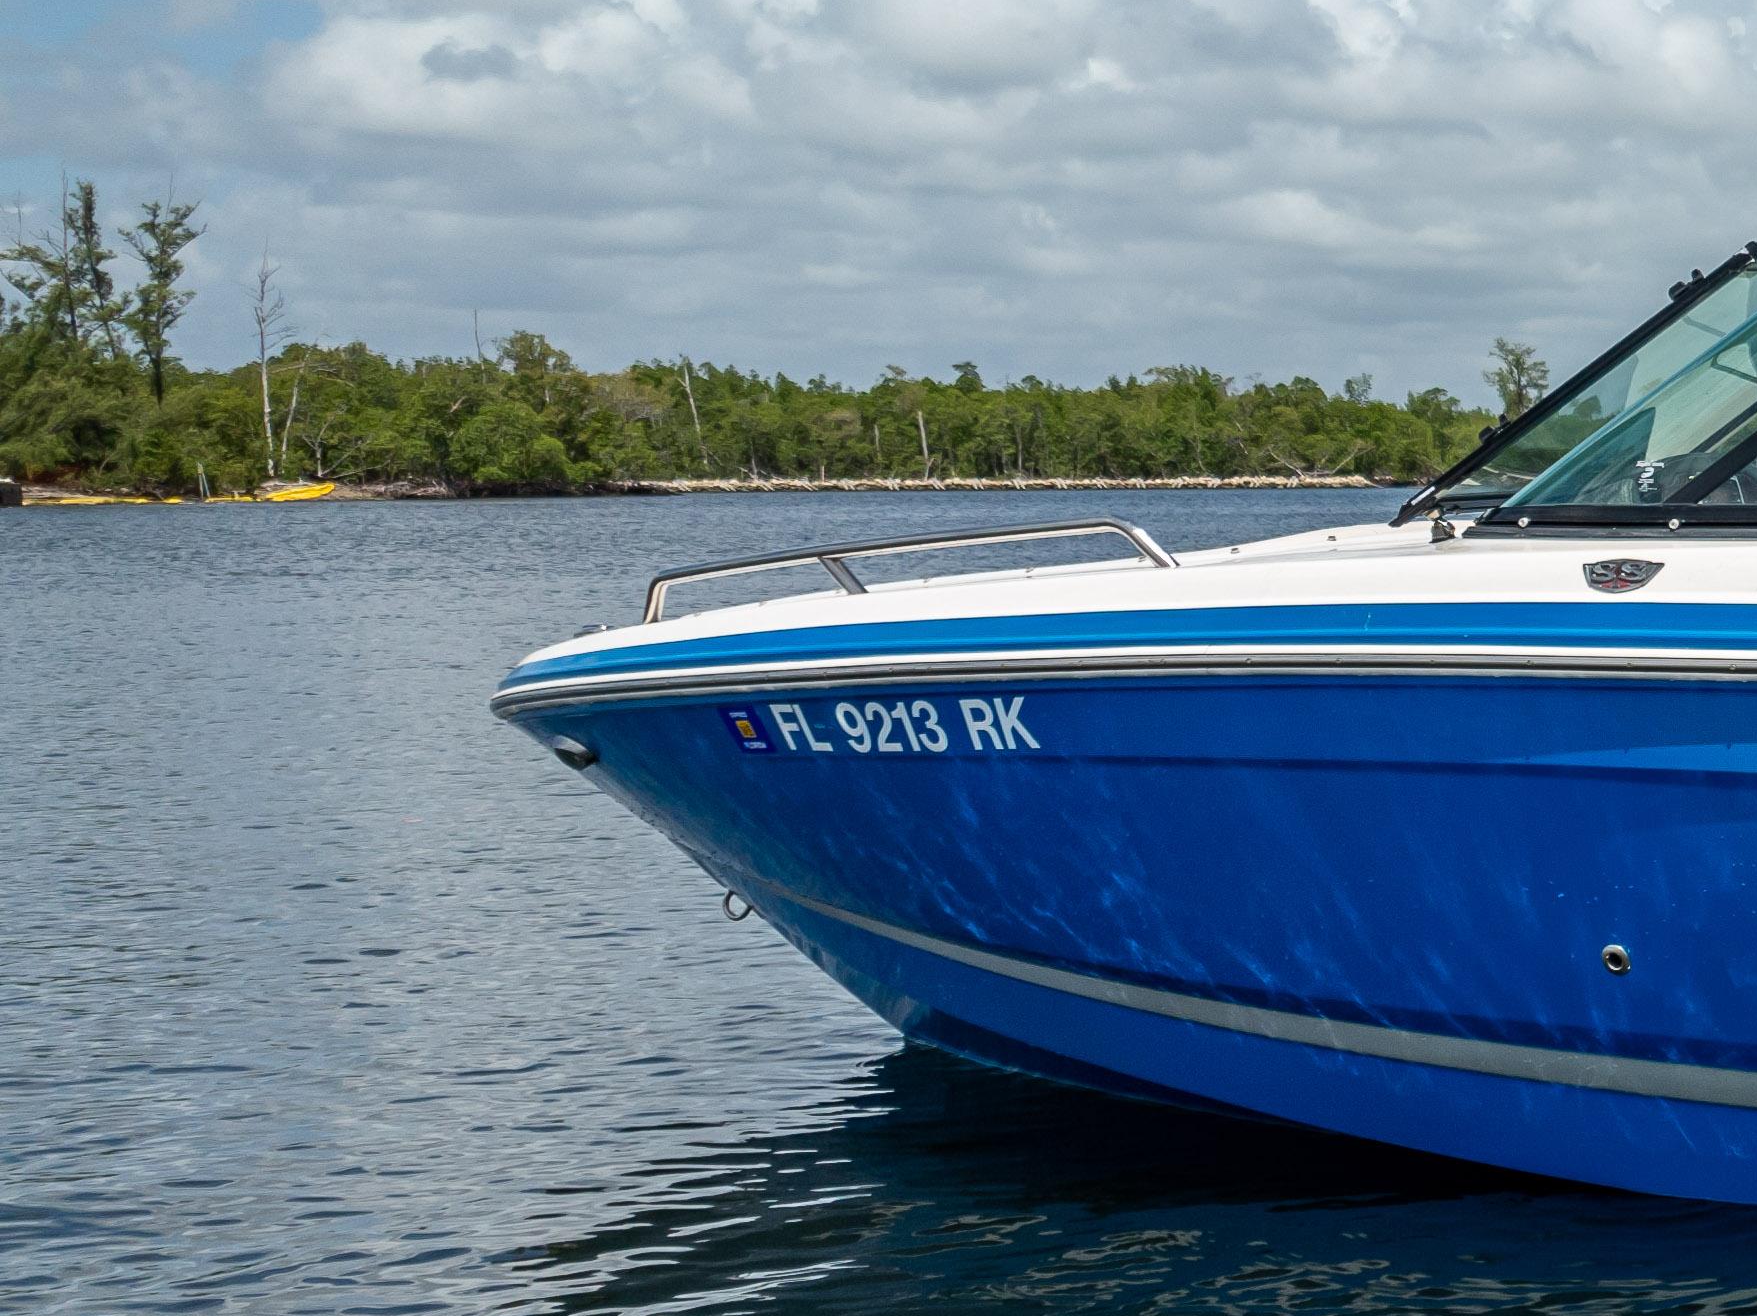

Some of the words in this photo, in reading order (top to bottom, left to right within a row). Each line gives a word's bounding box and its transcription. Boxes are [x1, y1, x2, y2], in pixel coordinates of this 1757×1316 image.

[769, 703, 833, 752] FL
[835, 700, 948, 754] 9213
[959, 696, 1041, 751] RK
